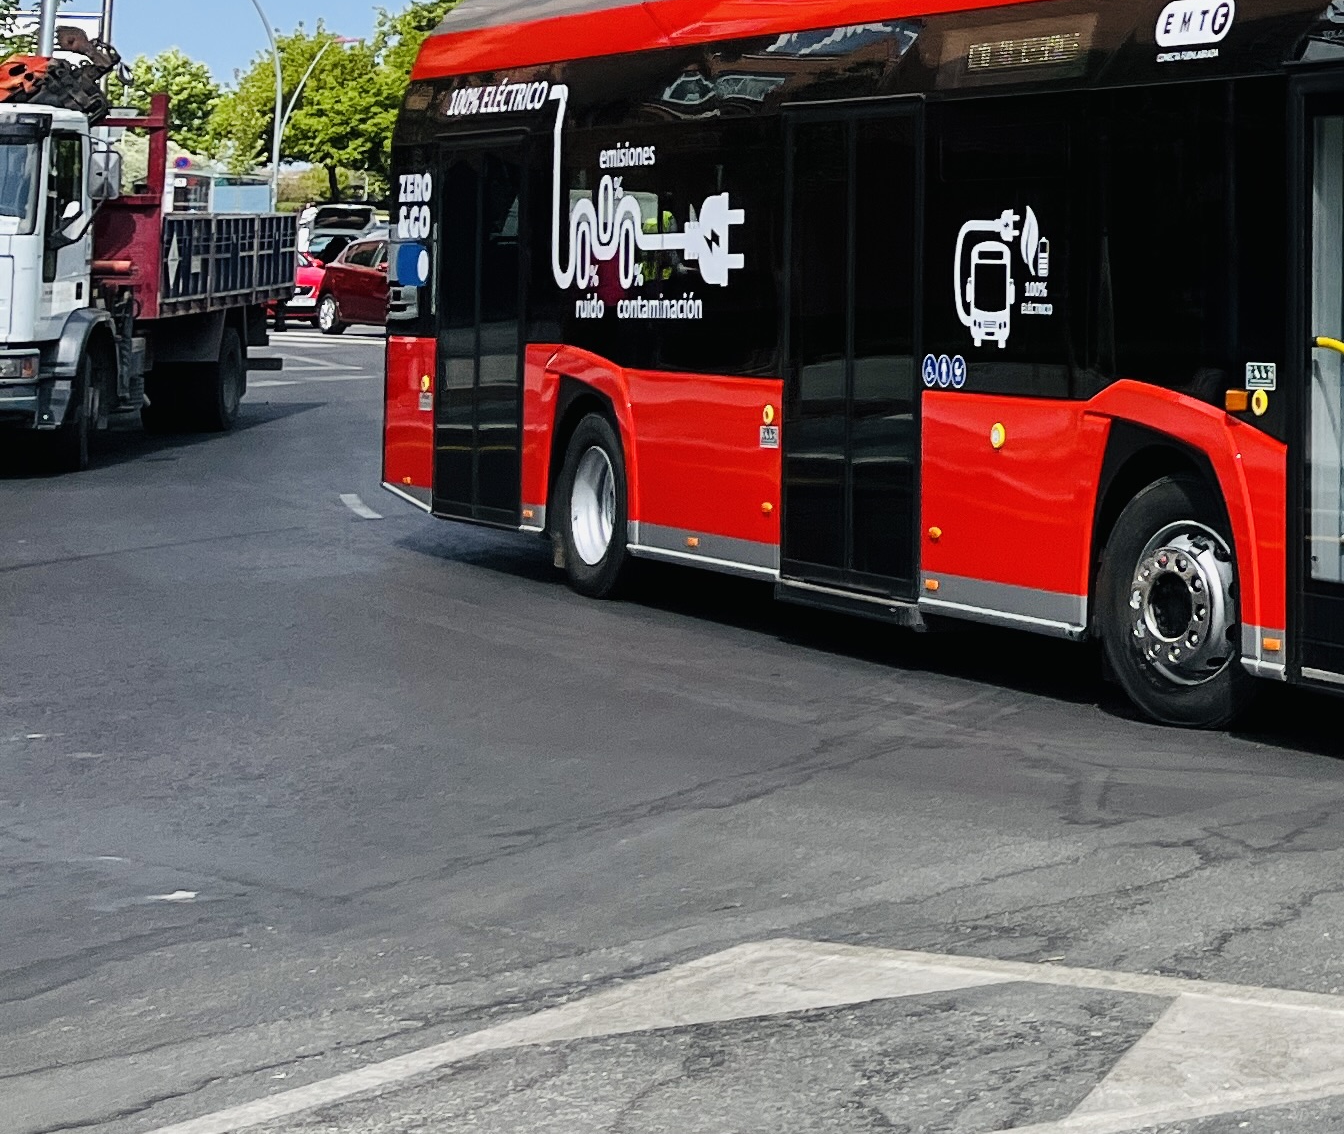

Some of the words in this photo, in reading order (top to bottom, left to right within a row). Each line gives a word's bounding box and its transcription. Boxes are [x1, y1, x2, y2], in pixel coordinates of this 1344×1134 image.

[1163, 4, 1229, 35] EMTF
[446, 86, 482, 116] 100%
[480, 77, 549, 113] ELÉCTRICO
[599, 142, 656, 168] emisiones
[398, 172, 433, 203] ZERO
[575, 293, 605, 319] ruido
[617, 292, 703, 319] contaminación
